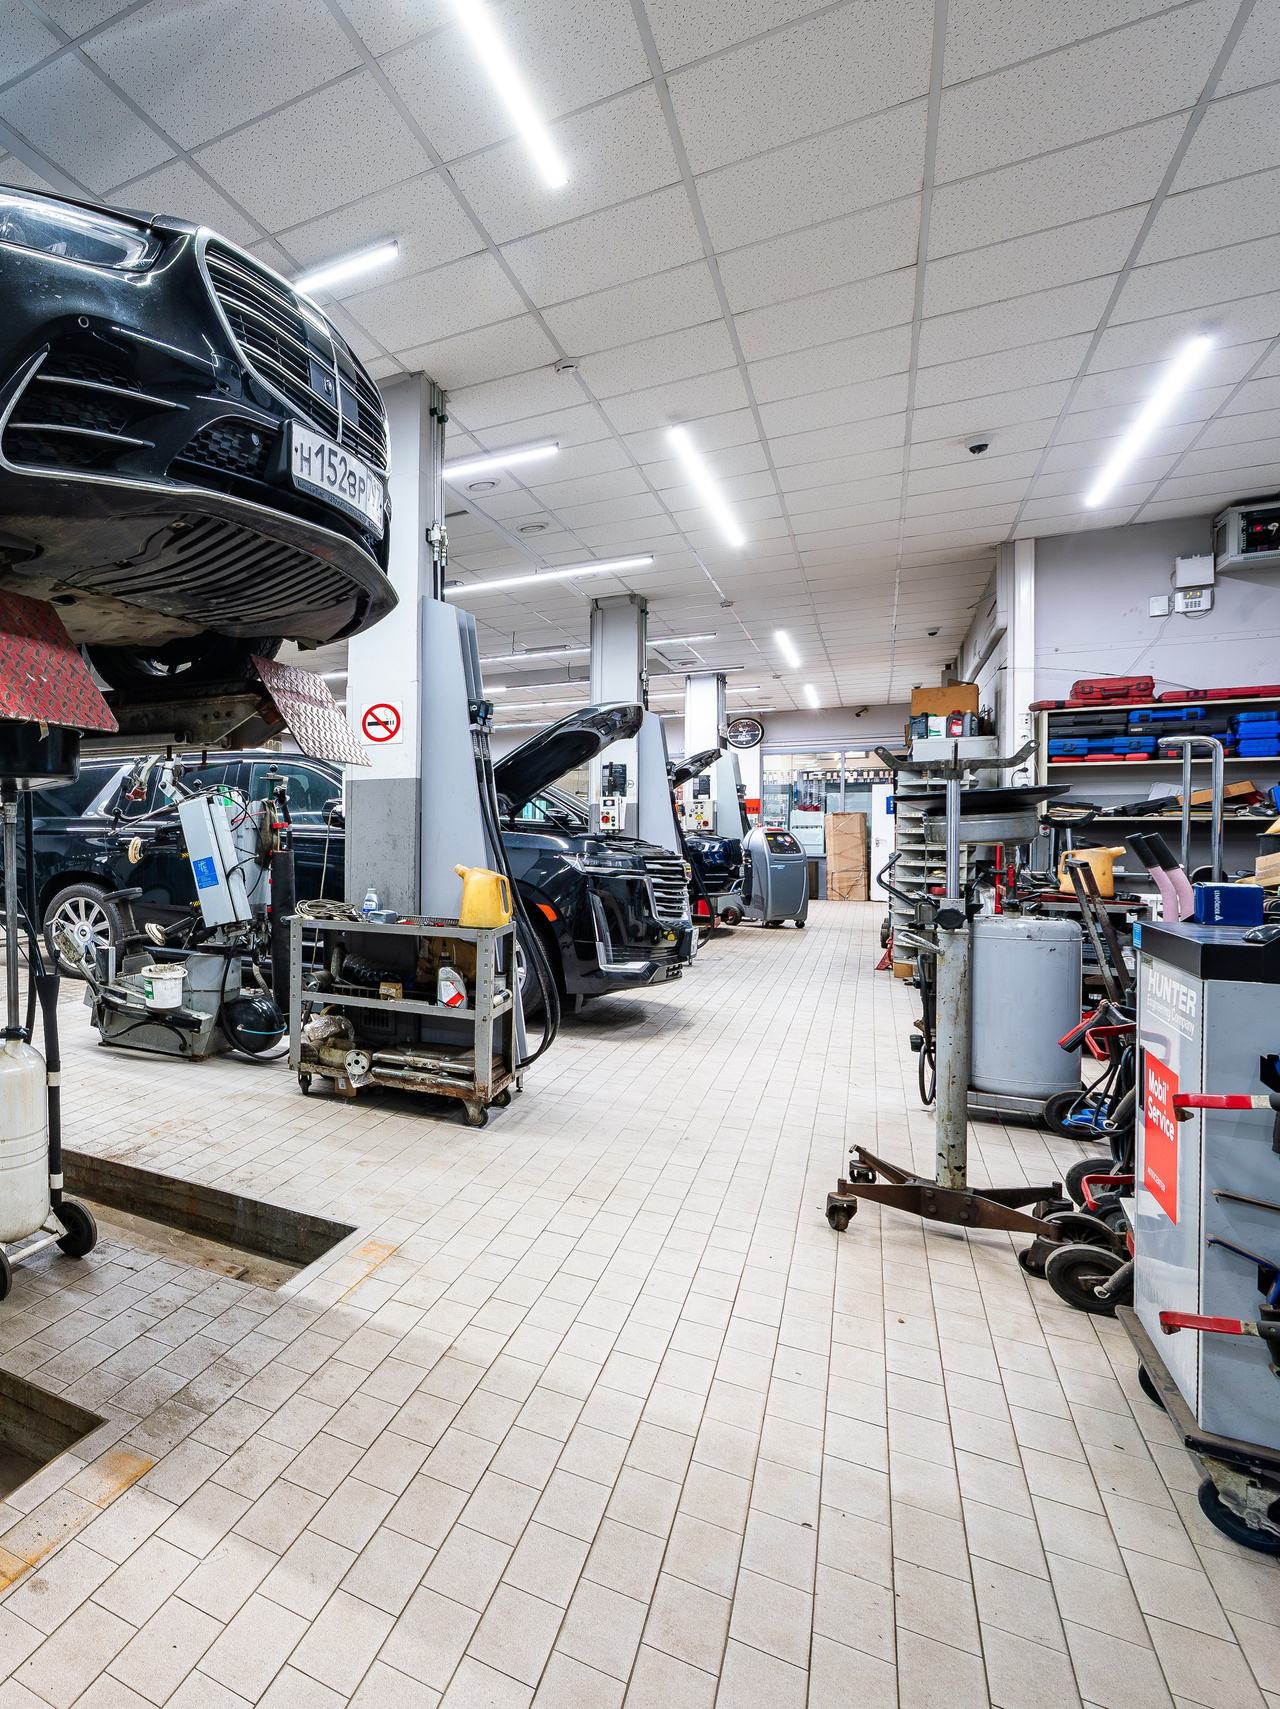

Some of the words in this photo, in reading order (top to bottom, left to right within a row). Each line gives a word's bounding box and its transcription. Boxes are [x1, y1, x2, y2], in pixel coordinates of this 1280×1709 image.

[1146, 993, 1172, 1022] Engineering
[1171, 1007, 1196, 1036] Company
[1147, 969, 1197, 1018] HUNTER
[1147, 1096, 1175, 1142] Service
[1147, 1165, 1167, 1194] AUTOCENTER
